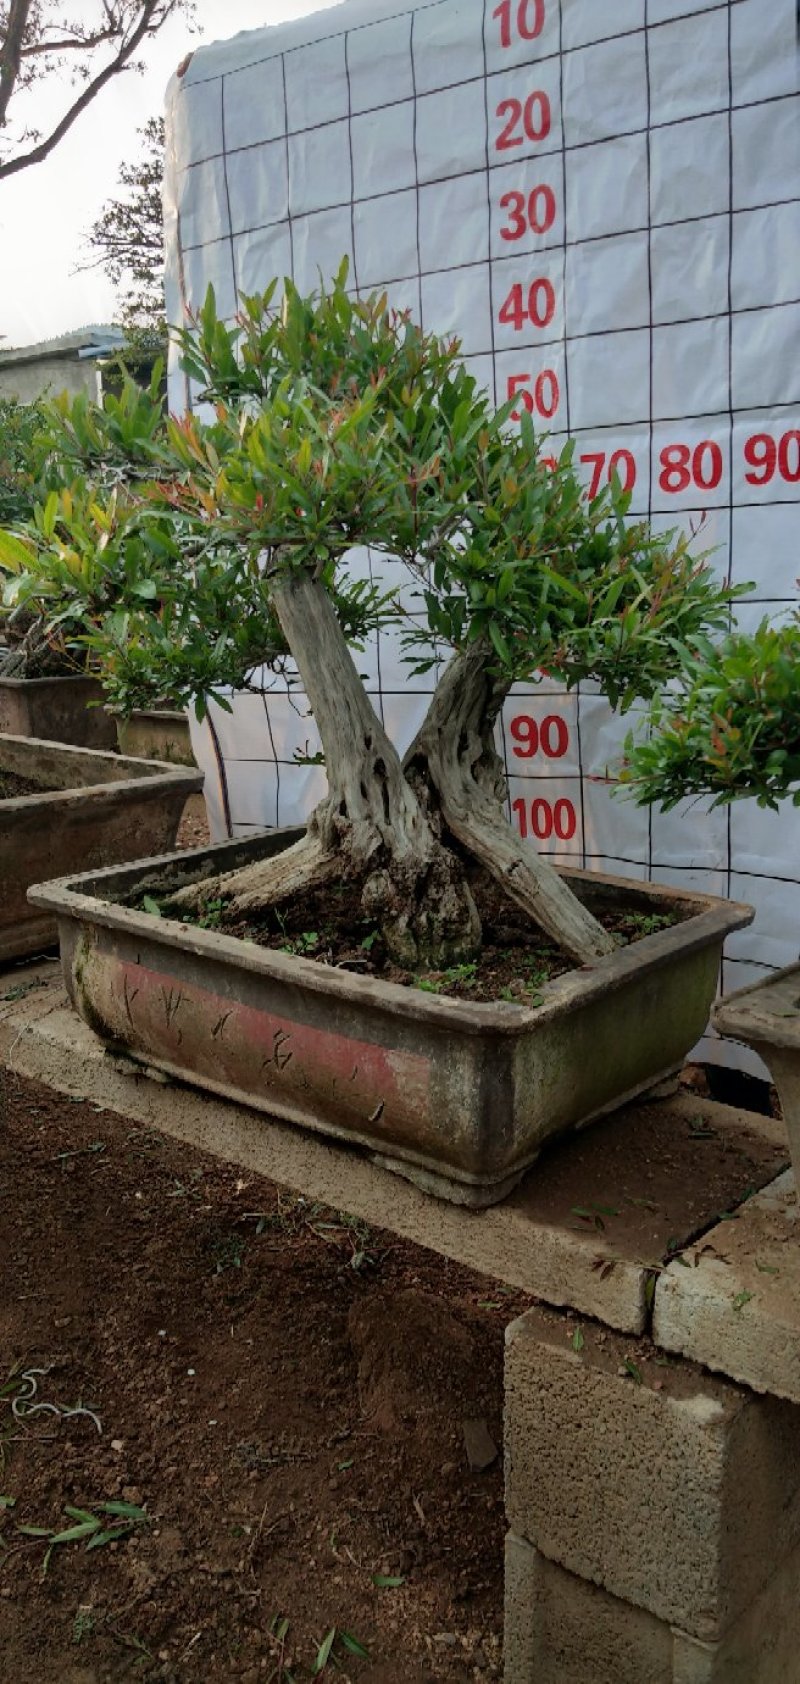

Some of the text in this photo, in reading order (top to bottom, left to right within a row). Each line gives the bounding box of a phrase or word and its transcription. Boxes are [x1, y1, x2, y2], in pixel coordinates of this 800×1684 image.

[493, 0, 545, 48] 10
[495, 91, 551, 151] 20
[500, 184, 556, 241] 30
[499, 277, 555, 331] 40
[507, 369, 559, 421] 50
[580, 430, 800, 501] 70 80 90
[510, 715, 569, 759] 90
[512, 798, 577, 840] 100
